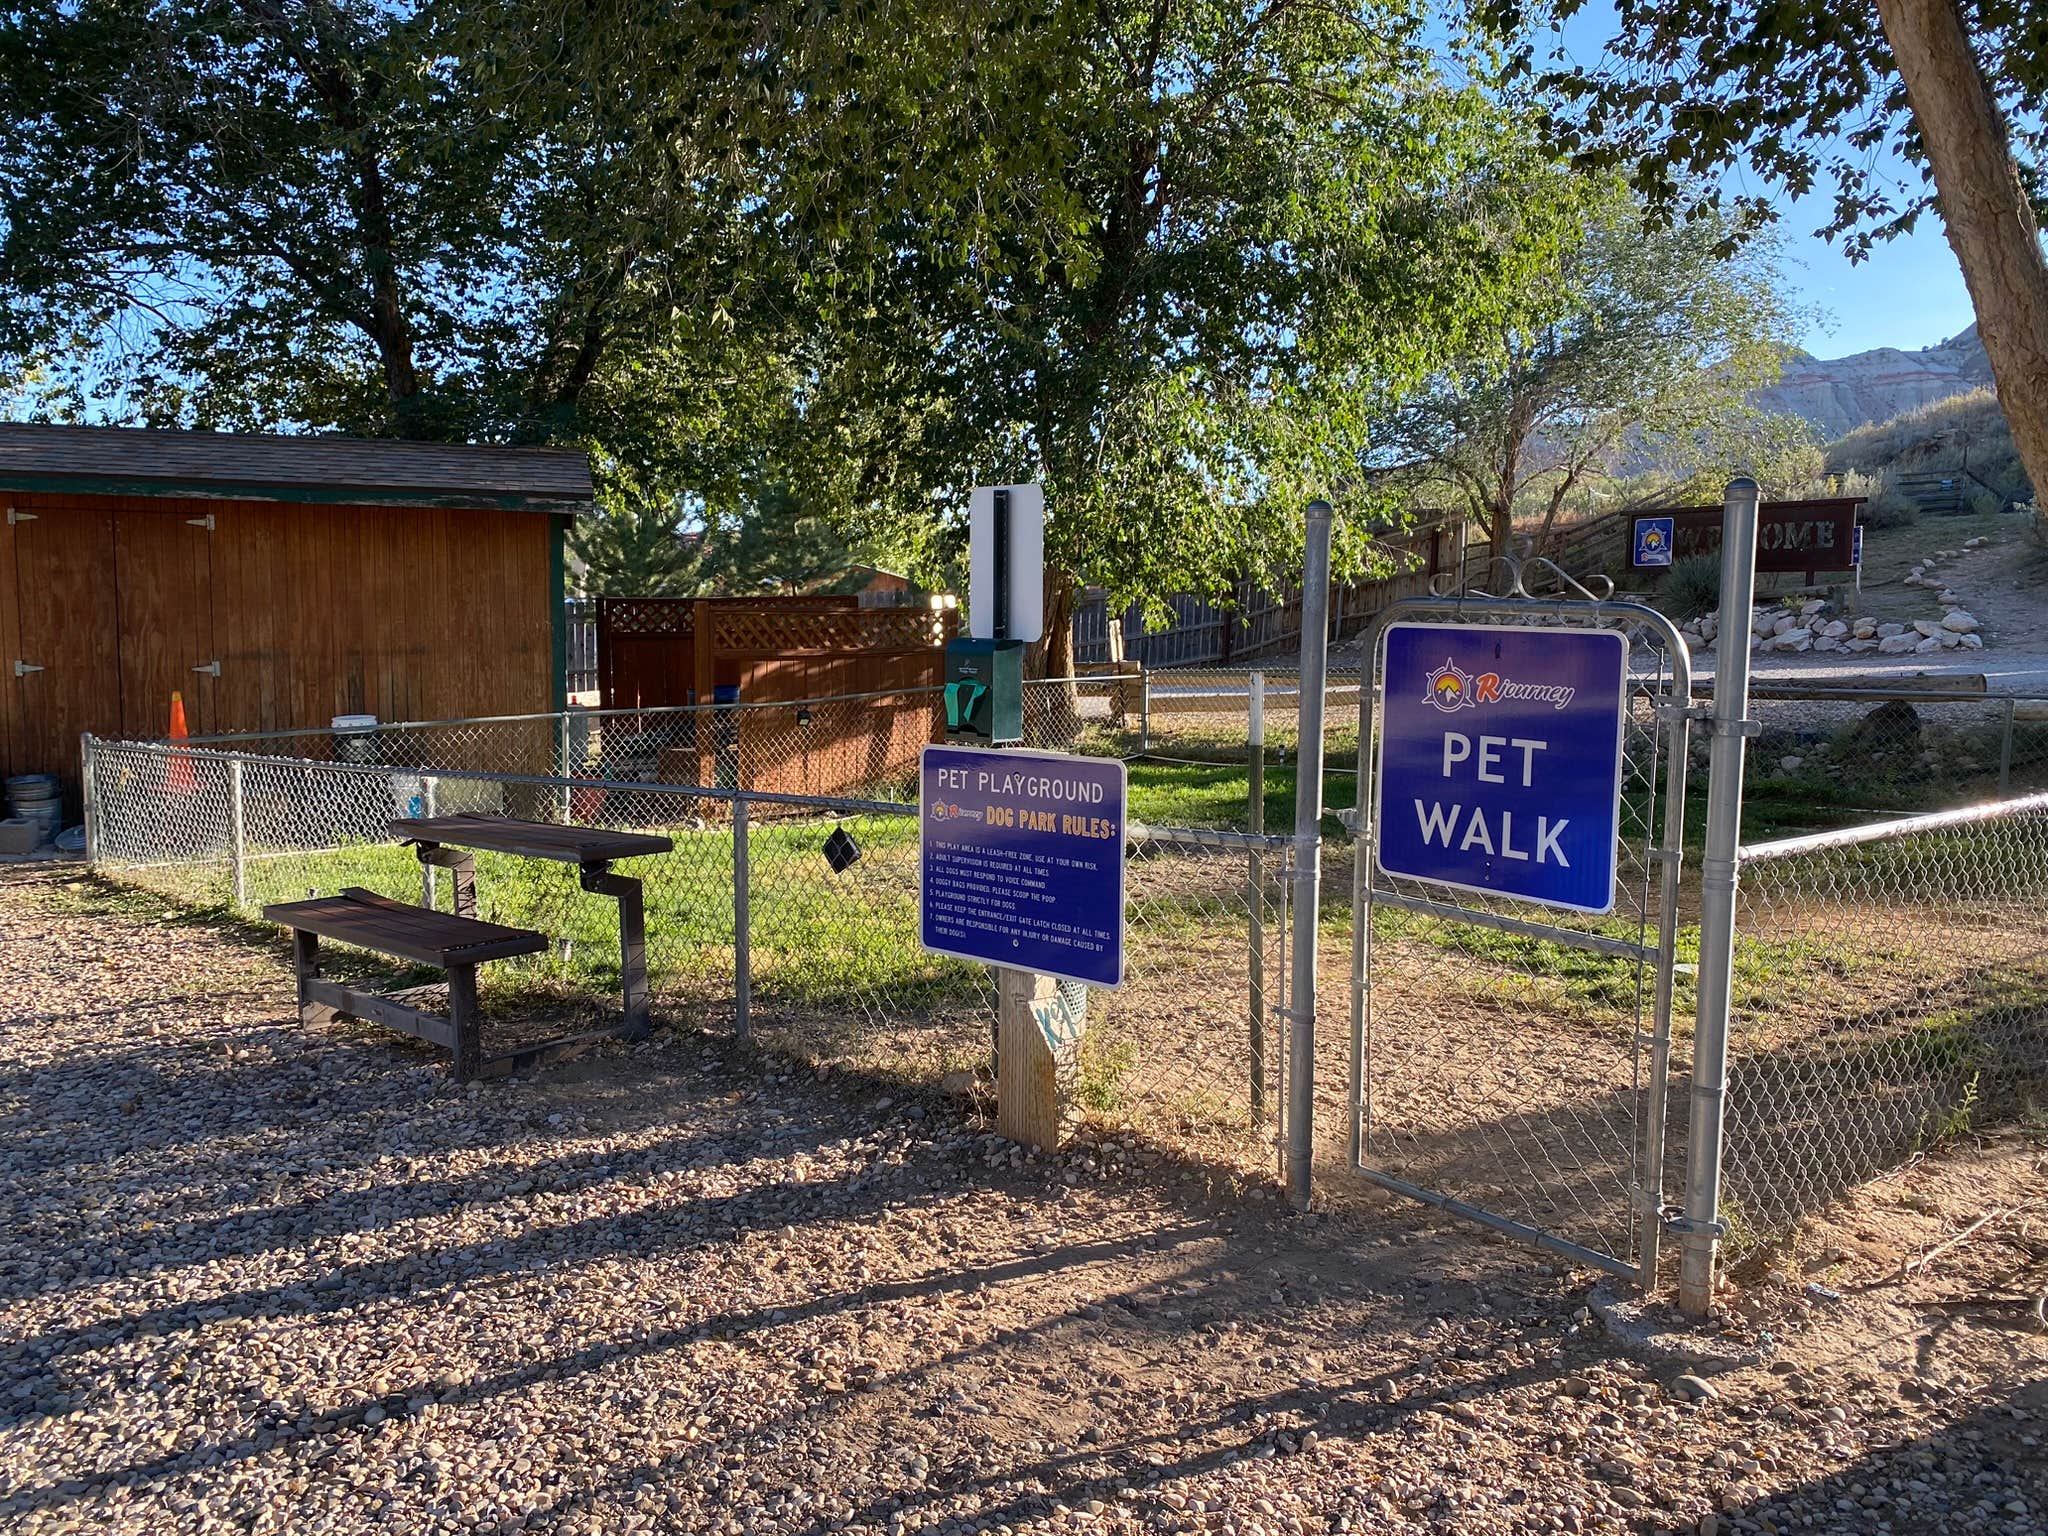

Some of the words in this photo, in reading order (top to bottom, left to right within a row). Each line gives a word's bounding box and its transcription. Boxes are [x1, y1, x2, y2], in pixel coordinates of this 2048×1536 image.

[1476, 673, 1576, 709] Rjourney
[1443, 732, 1547, 787] PET
[938, 768, 969, 789] PET
[978, 772, 1103, 804] PLAYGROUND
[986, 806, 1014, 827] DOG
[1019, 809, 1057, 833] PARK
[1062, 814, 1116, 840] RULES:
[1415, 799, 1570, 868] WALK
[936, 841, 946, 849] THIS
[947, 842, 960, 850] PLAY
[987, 848, 1018, 859] LEASH-FREE
[1035, 855, 1045, 863] USE
[1047, 856, 1054, 864] AT
[1056, 858, 1069, 866] YOUR
[1071, 860, 1083, 868] OWN
[936, 853, 950, 861] ADULT
[952, 856, 982, 866] SUPERVISION
[990, 860, 1013, 871] REQUIRED
[1023, 866, 1032, 874] ALL
[936, 878, 951, 886] DOGGY
[952, 880, 965, 888] BAGS
[992, 887, 1011, 896] PLEASE
[1013, 890, 1029, 898] SCOOP
[1031, 893, 1040, 901] THE
[946, 866, 958, 875] DOGS
[960, 869, 972, 877] MUST
[974, 871, 995, 880] RESPOND
[1006, 876, 1019, 885] VOICE
[936, 890, 966, 901] PLAYGROUND
[967, 895, 989, 904] STRICTLY
[991, 899, 1000, 907] FOR
[935, 914, 954, 924] OWNERS
[956, 918, 964, 926] ARE
[966, 920, 997, 932] RESPONSIBLE
[1023, 930, 1040, 939] INJURY
[1050, 936, 1071, 946] DAMAGE
[1074, 940, 1094, 950] CAUSED
[1096, 944, 1103, 952] BY
[936, 902, 952, 911] PLEASE
[954, 905, 966, 913] KEEP
[978, 909, 1016, 922] ENTRANCE/EXIT
[1019, 917, 1031, 925] GATE
[1033, 920, 1050, 928] LATCH
[1051, 923, 1071, 932] CLOSED
[1073, 926, 1080, 934] AT
[1082, 928, 1092, 936] ALL
[936, 926, 948, 935] THEIR
